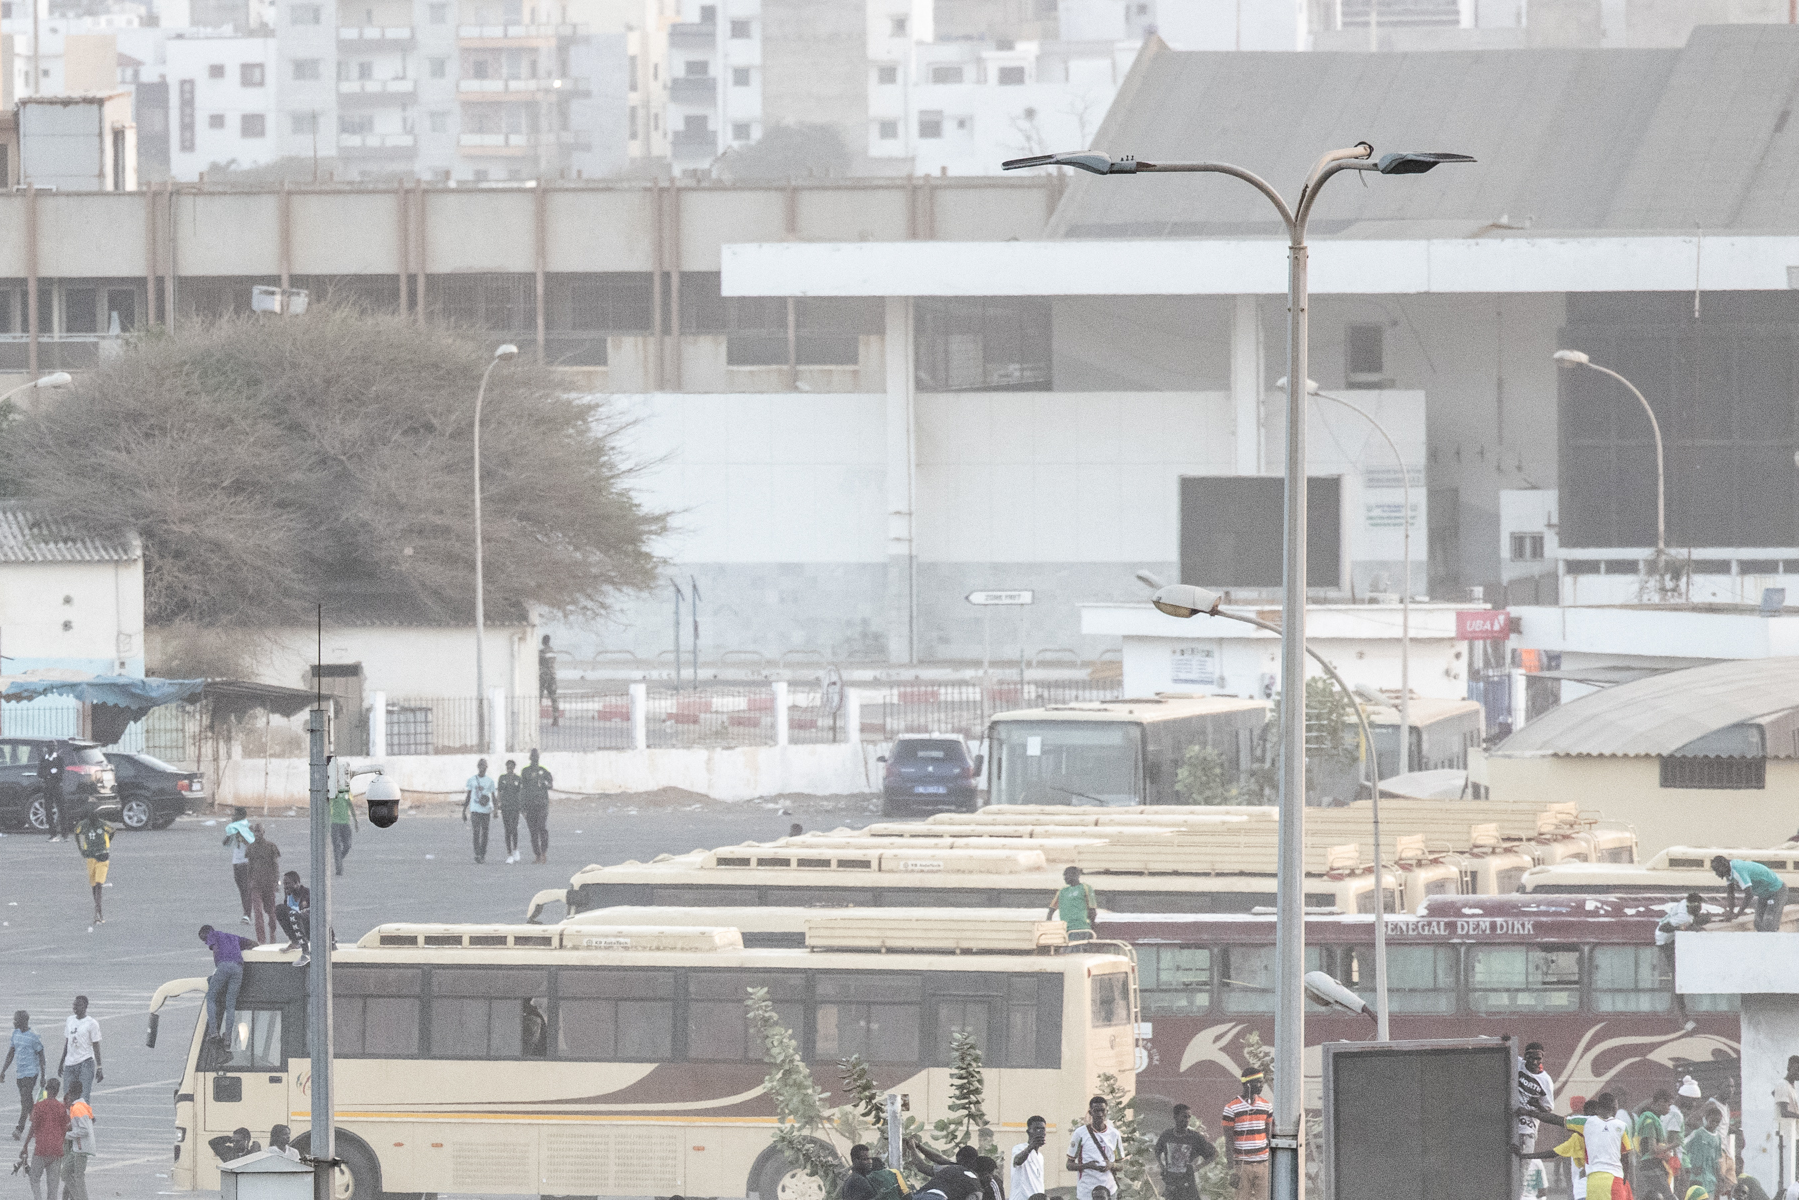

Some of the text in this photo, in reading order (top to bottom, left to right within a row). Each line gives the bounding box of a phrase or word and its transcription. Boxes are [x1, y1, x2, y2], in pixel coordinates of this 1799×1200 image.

[1467, 620, 1492, 631] UBA
[1384, 920, 1534, 935] ENEGAL DEM DIKK
